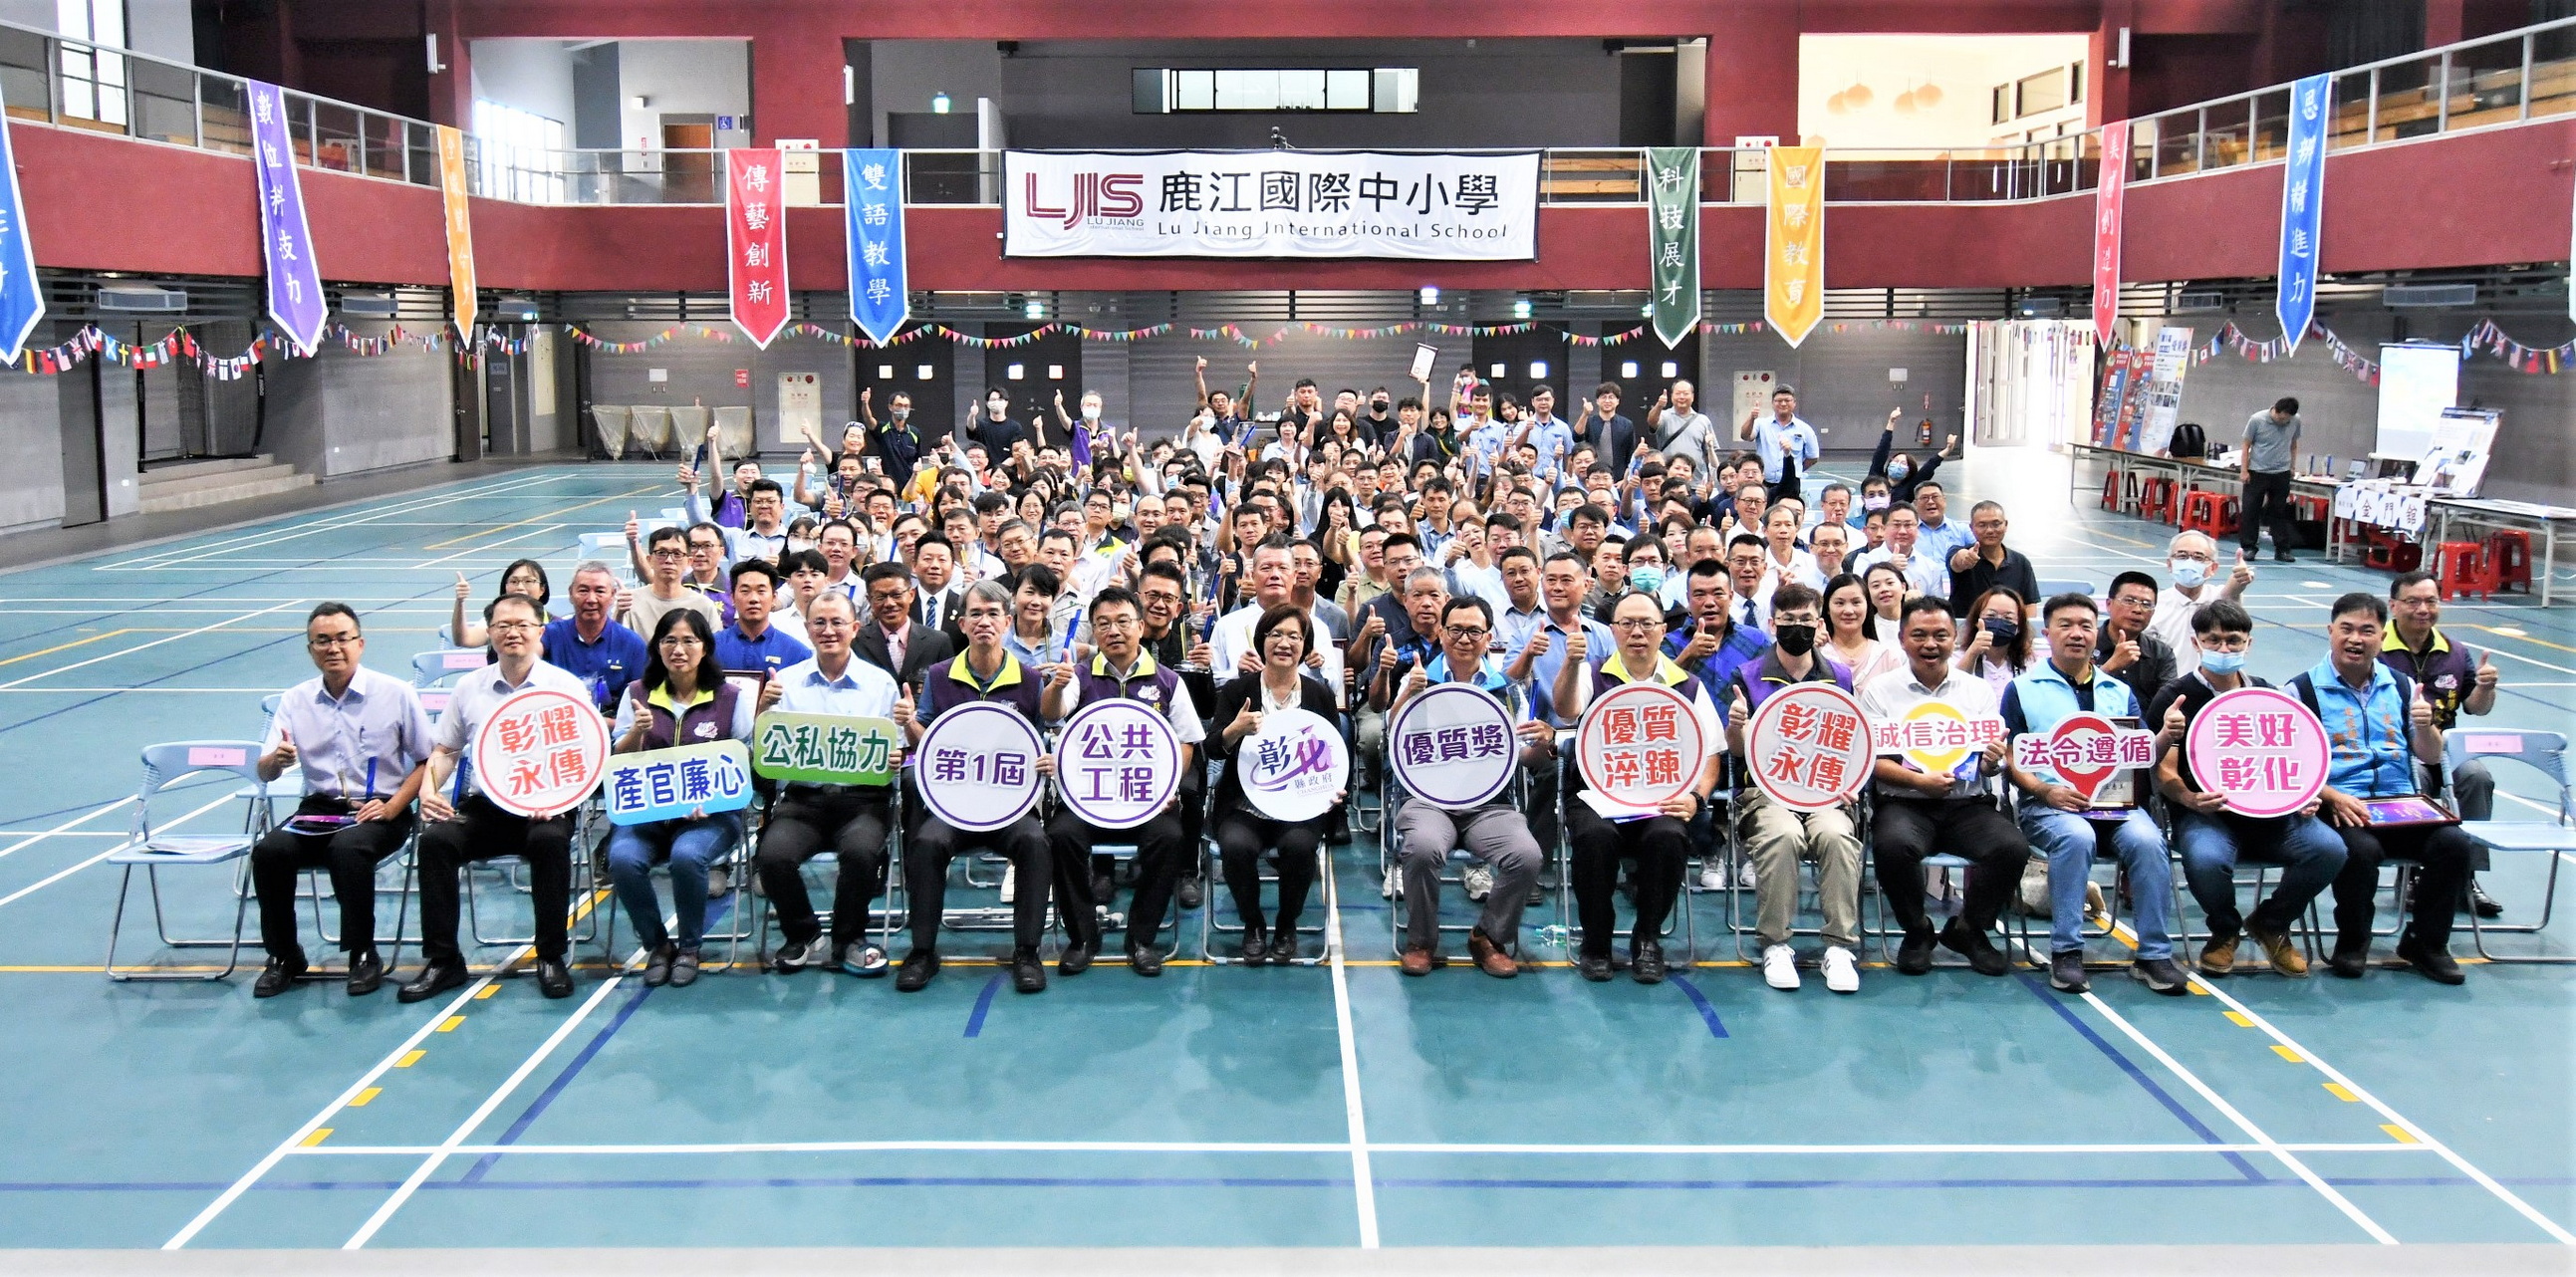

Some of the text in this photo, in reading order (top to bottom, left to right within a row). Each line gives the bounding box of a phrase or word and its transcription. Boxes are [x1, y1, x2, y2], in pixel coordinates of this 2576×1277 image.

[1025, 172, 1144, 231] LJIS
[1159, 170, 1498, 215] 鹿江國際中小學
[742, 163, 773, 306] 傳藝創新
[861, 162, 892, 306] 雙語教學
[1106, 218, 1145, 227] JIANG
[1159, 220, 1508, 240] Lu Jiang International School
[1658, 165, 1684, 307] 科技展才
[1783, 165, 1810, 305] 國際教育
[498, 704, 580, 755] 彰耀
[1081, 723, 1154, 759] 公共
[1403, 724, 1505, 766] 優質獎
[1601, 704, 1677, 746] 優質
[1777, 702, 1858, 753] 彰耀
[1875, 719, 2001, 748] 誠信治理
[2215, 713, 2298, 748] 美好
[763, 724, 890, 771] 公私協力
[932, 748, 1025, 787] 第1屆
[1256, 735, 1331, 777] 彰化
[2019, 735, 2152, 767] 法令遵循
[509, 748, 589, 797] 永傳
[614, 754, 744, 811] 產官廉心
[1080, 767, 1154, 802] 工程
[1767, 746, 1847, 793] 永傳
[2219, 757, 2302, 792] 彰化
